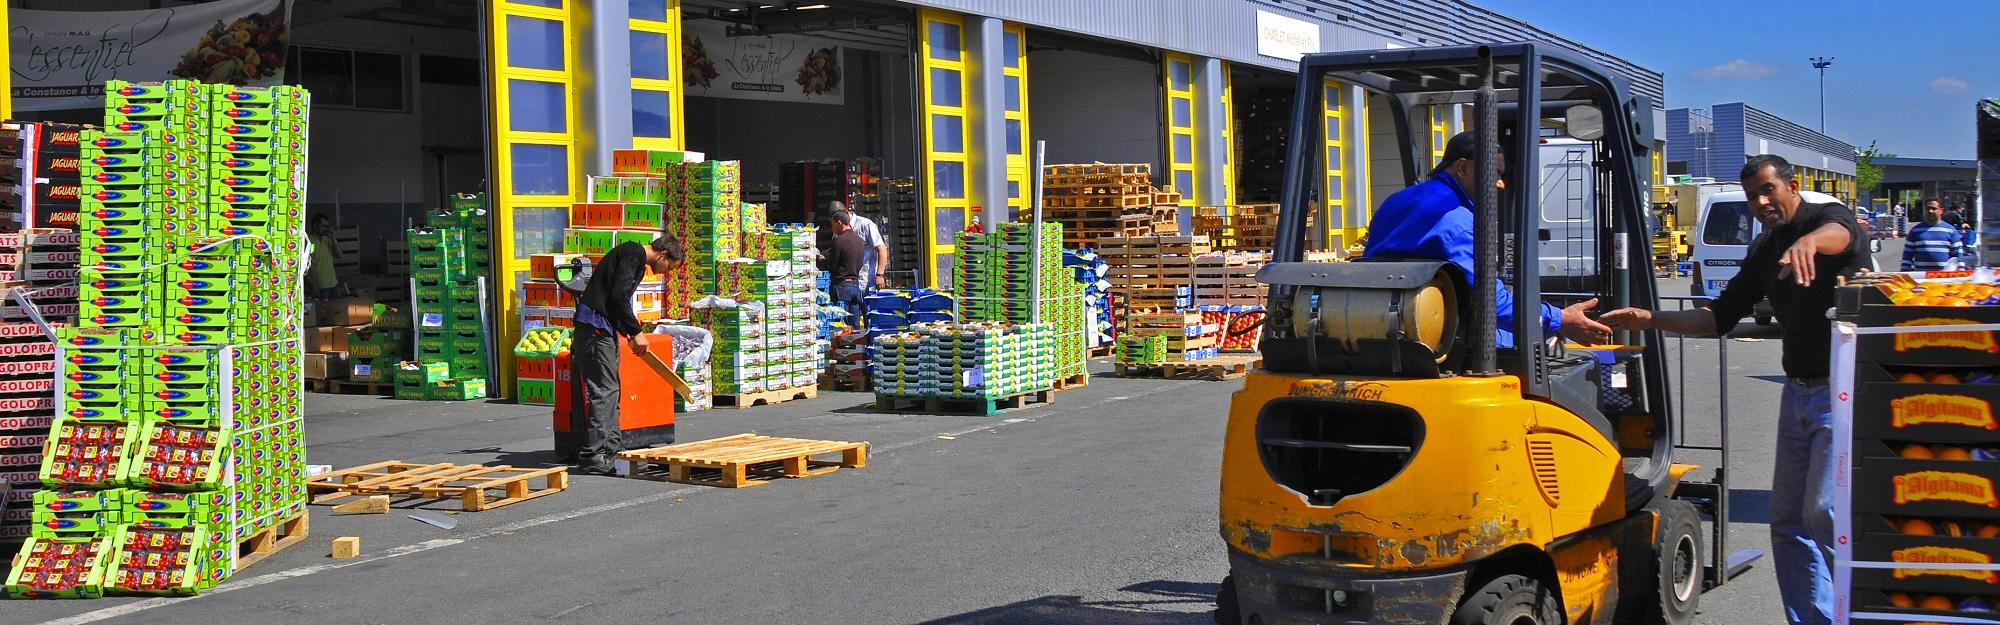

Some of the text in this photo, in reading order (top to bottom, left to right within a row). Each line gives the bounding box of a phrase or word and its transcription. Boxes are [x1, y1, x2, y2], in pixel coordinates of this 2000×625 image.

[23, 87, 81, 96] Constance
[50, 132, 79, 143] JAGUAR
[50, 158, 78, 169] JAGUAR
[49, 186, 77, 197] JAGUAR
[49, 212, 77, 222] JAGUAR
[559, 370, 571, 381] 18
[0, 381, 55, 391] GOLOPR
